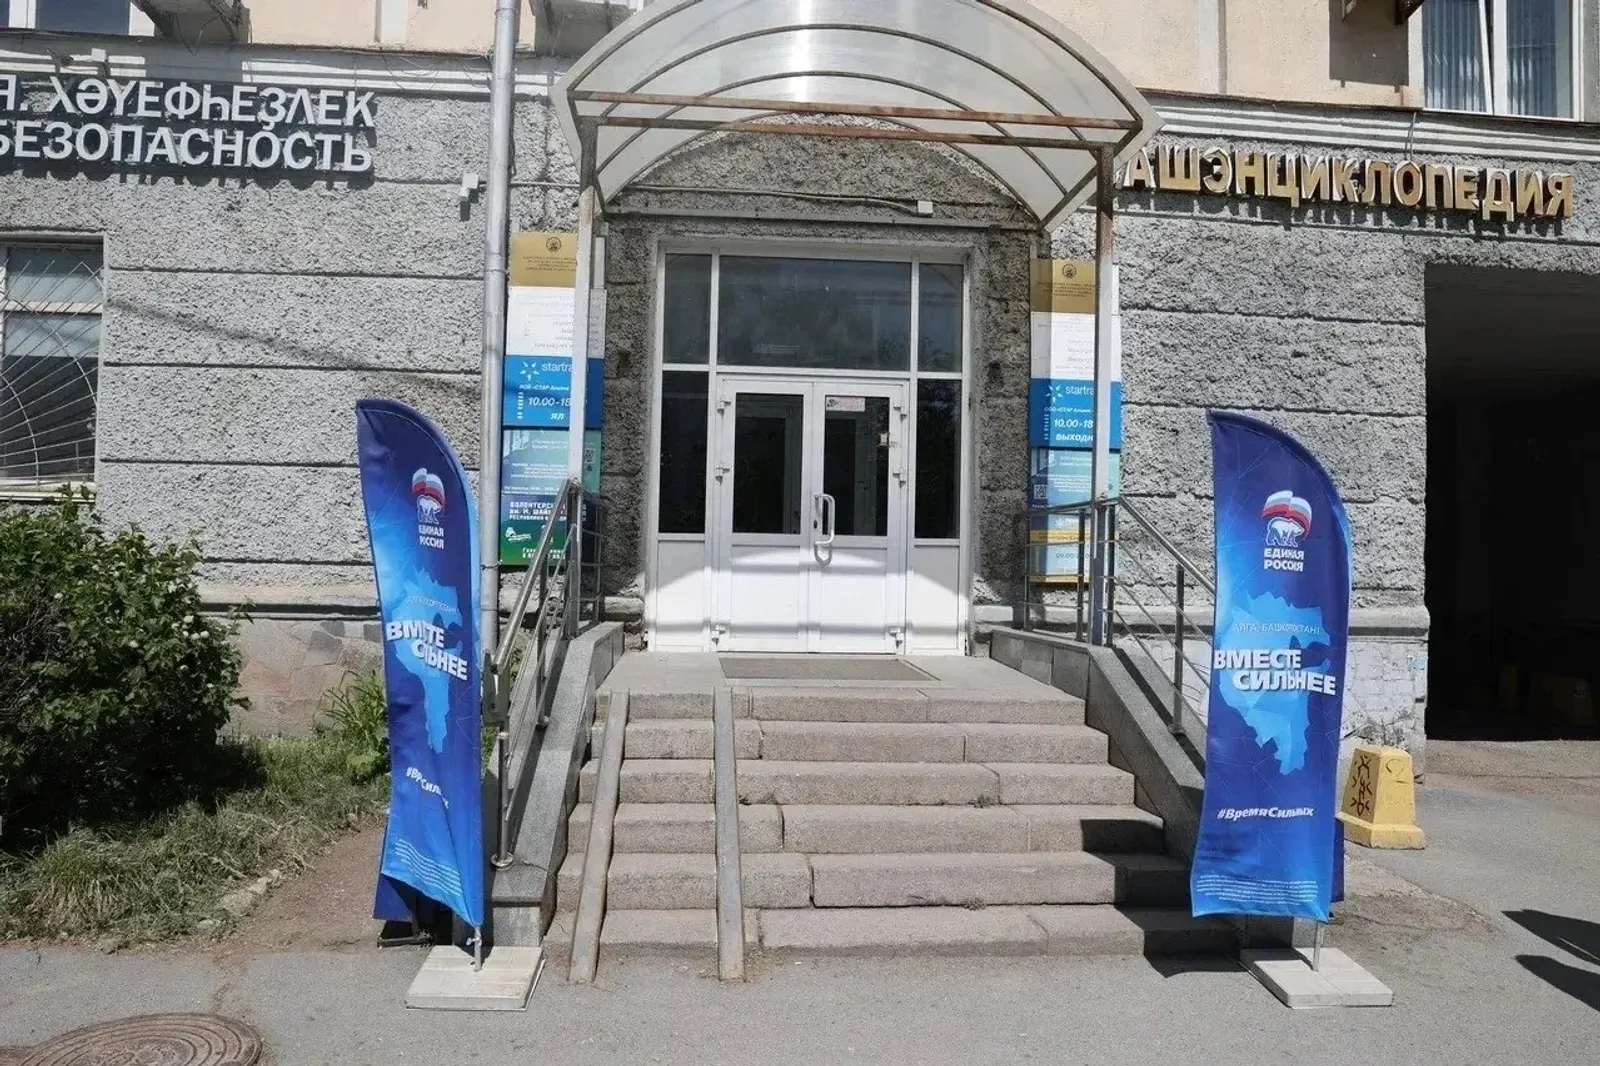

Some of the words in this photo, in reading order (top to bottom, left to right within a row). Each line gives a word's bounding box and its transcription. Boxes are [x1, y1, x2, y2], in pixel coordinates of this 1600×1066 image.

[1114, 144, 1574, 222] АШЭНЦИКЛОПЕДИЯ
[541, 362, 574, 372] startra
[1065, 385, 1094, 395] startra
[528, 397, 571, 407] 10.00-18
[1054, 418, 1093, 428] 10.00-18
[1056, 434, 1093, 442] ВЫХОДН
[386, 620, 445, 648] ВМТЕ
[411, 639, 468, 680] СЬНЕЕ
[1214, 648, 1301, 669] ВМЕСТЕ
[1232, 669, 1336, 695] СИЛЬНЕЕ
